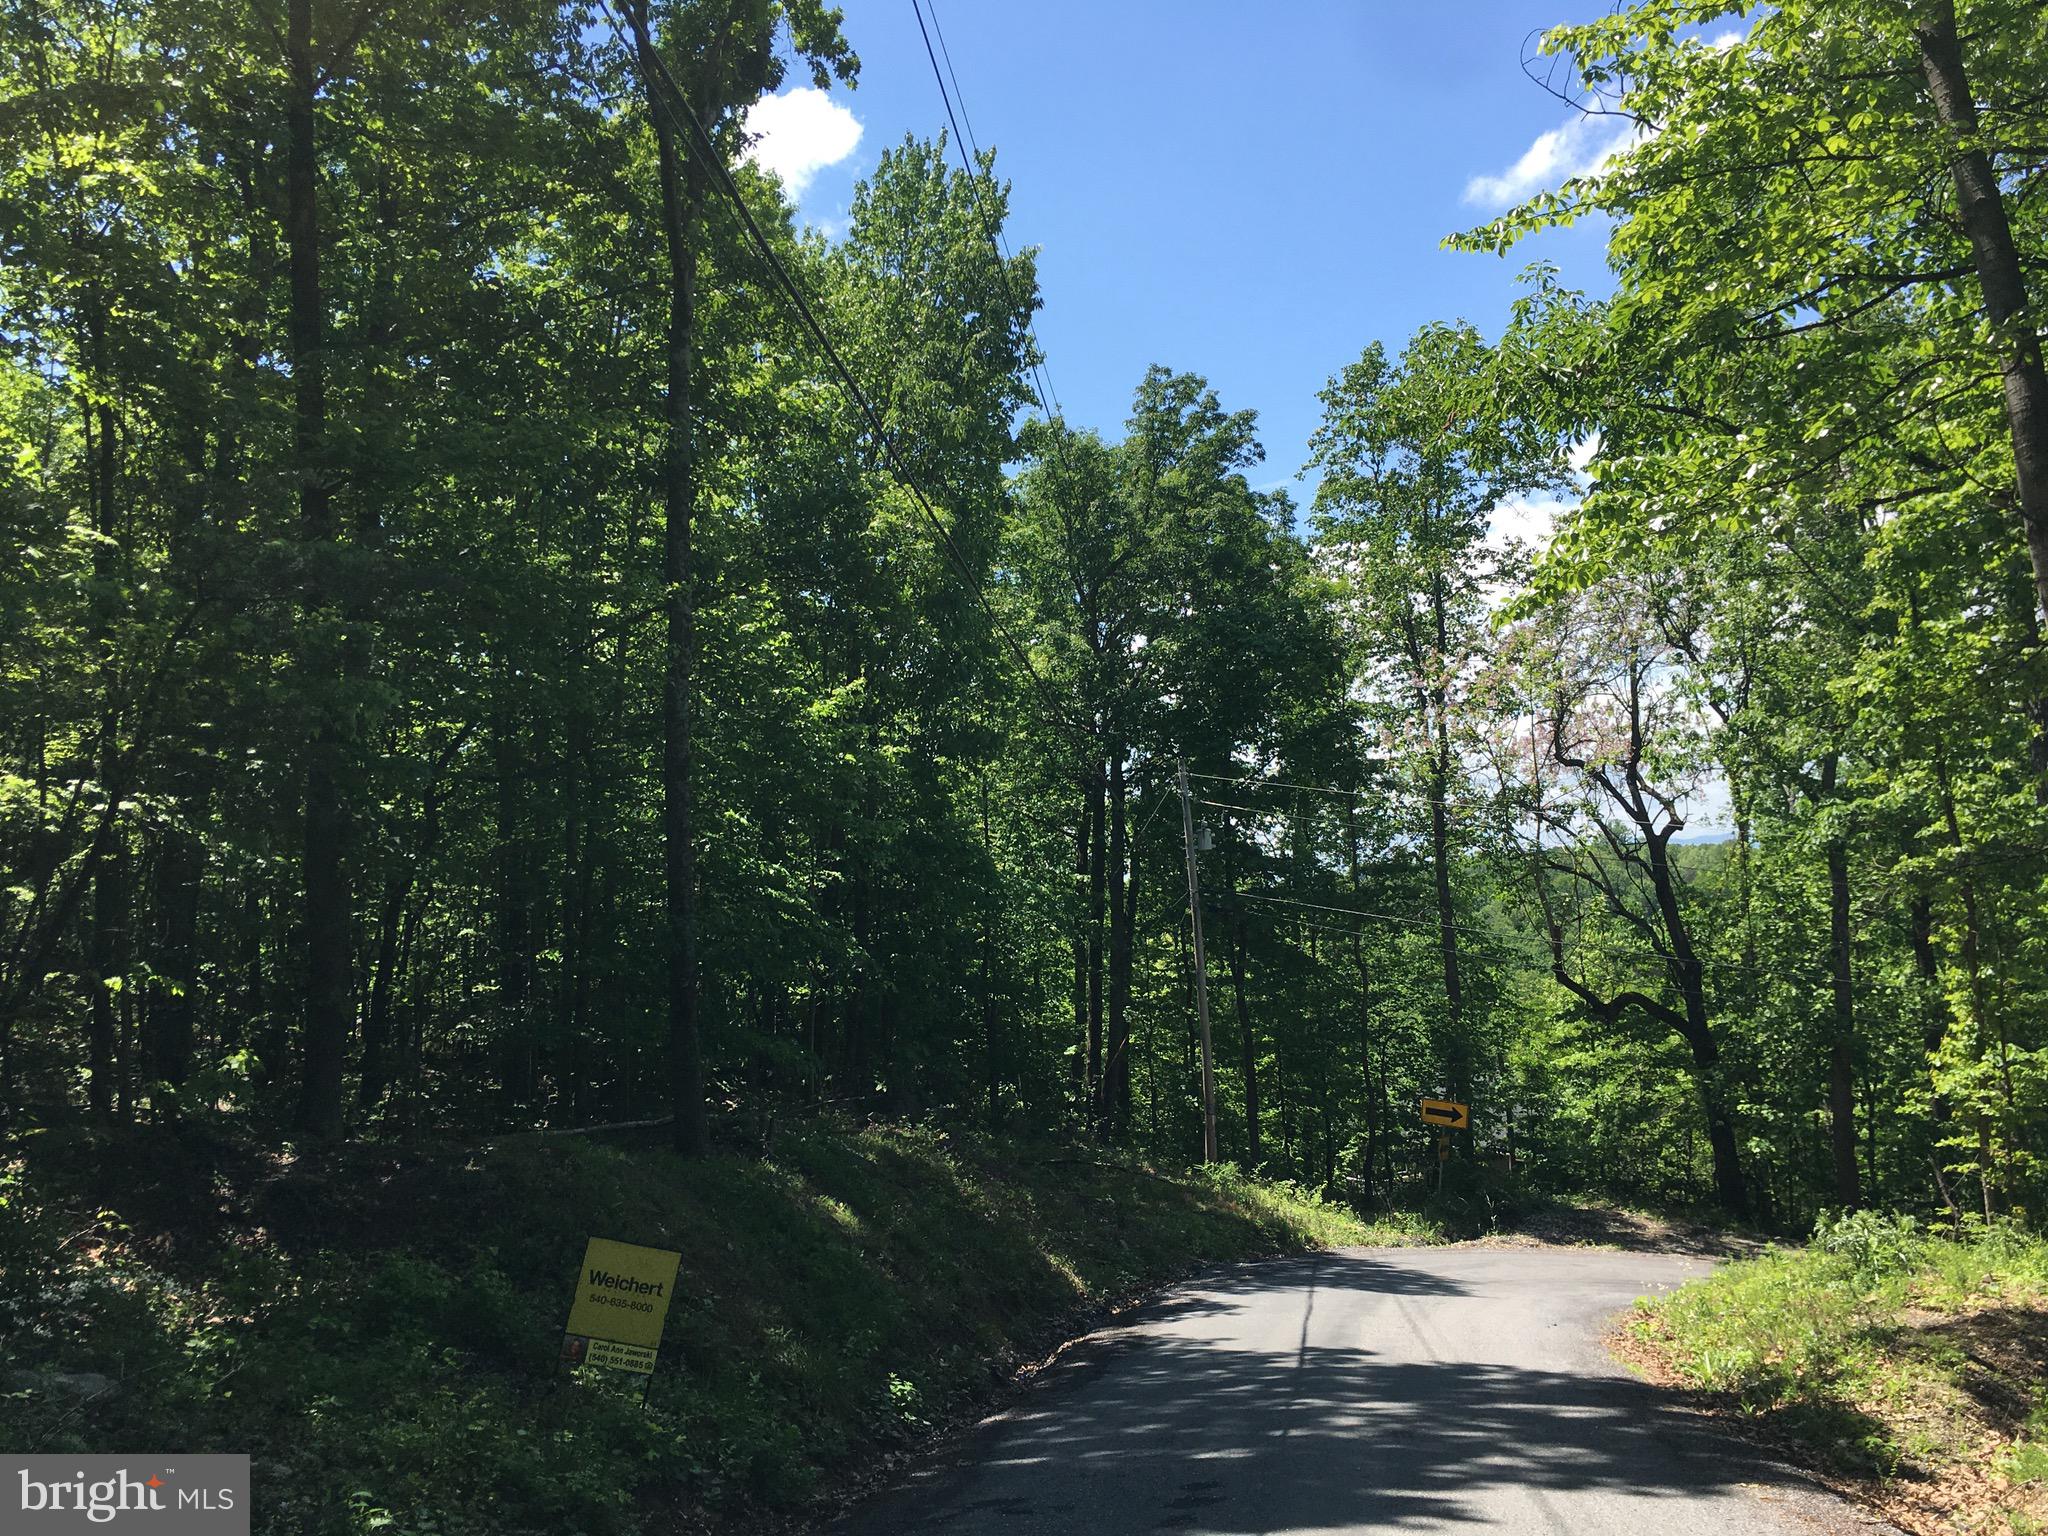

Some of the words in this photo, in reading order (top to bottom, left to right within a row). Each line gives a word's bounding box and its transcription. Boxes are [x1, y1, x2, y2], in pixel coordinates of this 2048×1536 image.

[589, 1269, 664, 1297] Weichert
[592, 1342, 610, 1353] Carol
[611, 1345, 624, 1354] Ann
[589, 1353, 608, 1364] (540)
